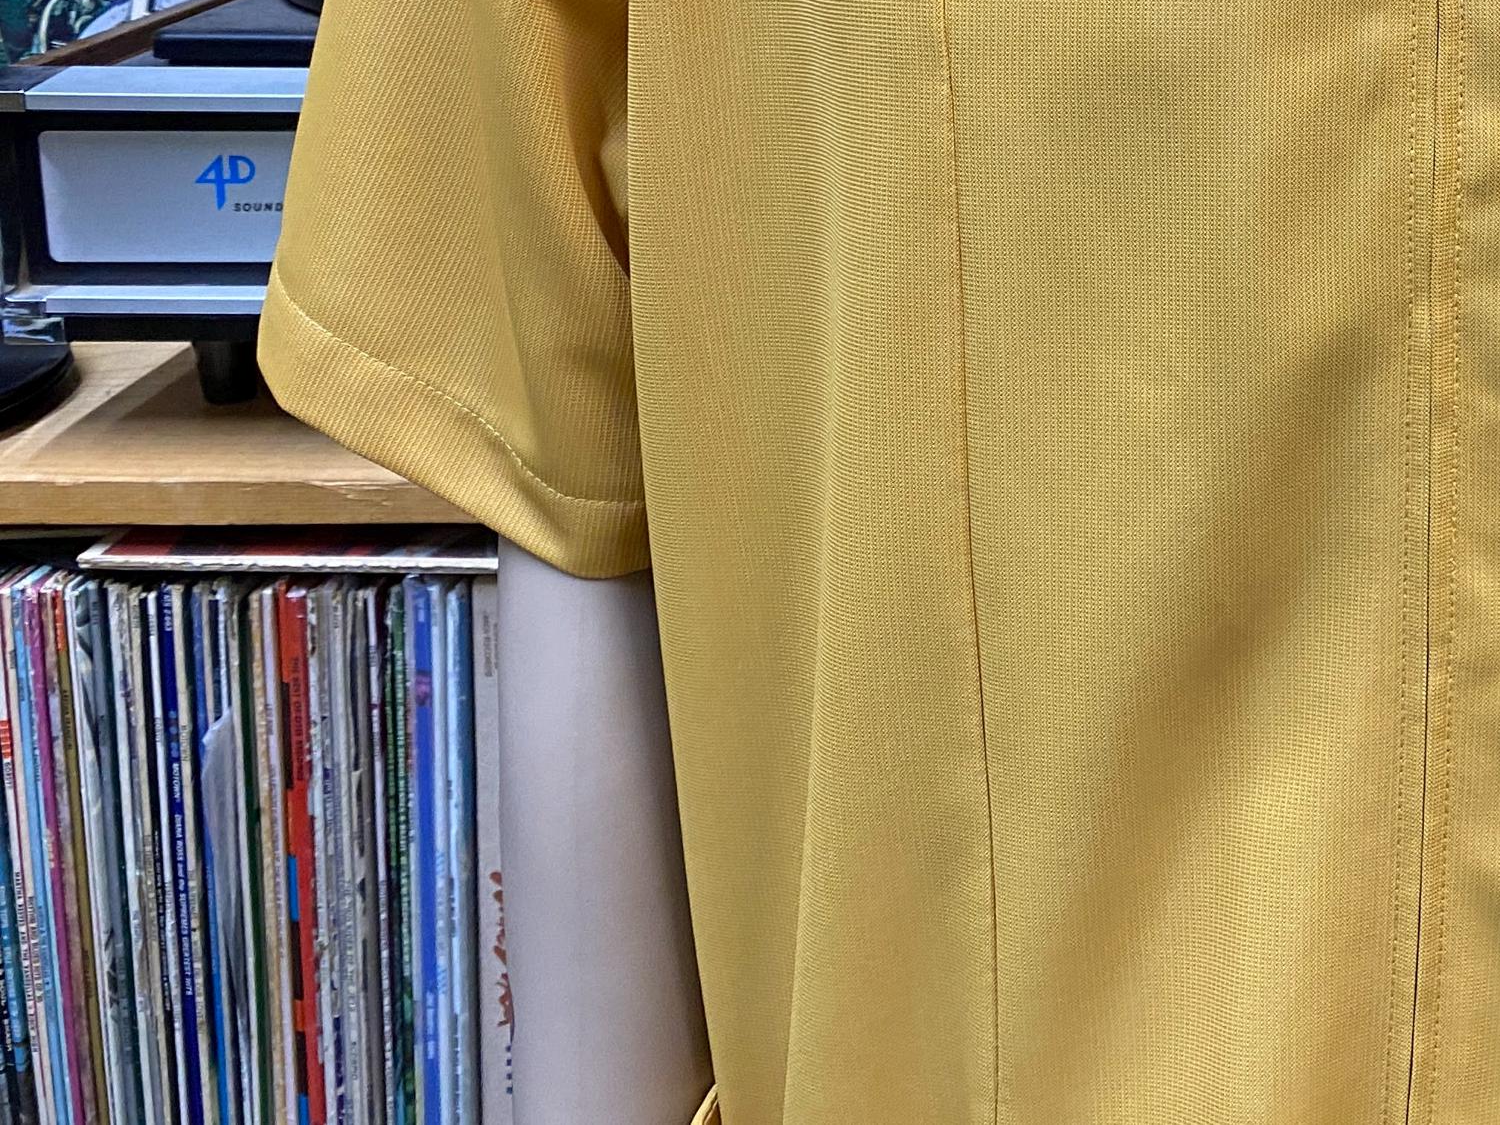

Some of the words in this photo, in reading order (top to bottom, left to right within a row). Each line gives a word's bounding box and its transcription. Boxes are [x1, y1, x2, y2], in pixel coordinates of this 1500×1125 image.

[176, 840, 185, 861] ROSS
[179, 893, 189, 935] SUPREMES
[181, 936, 191, 975] GREATEST
